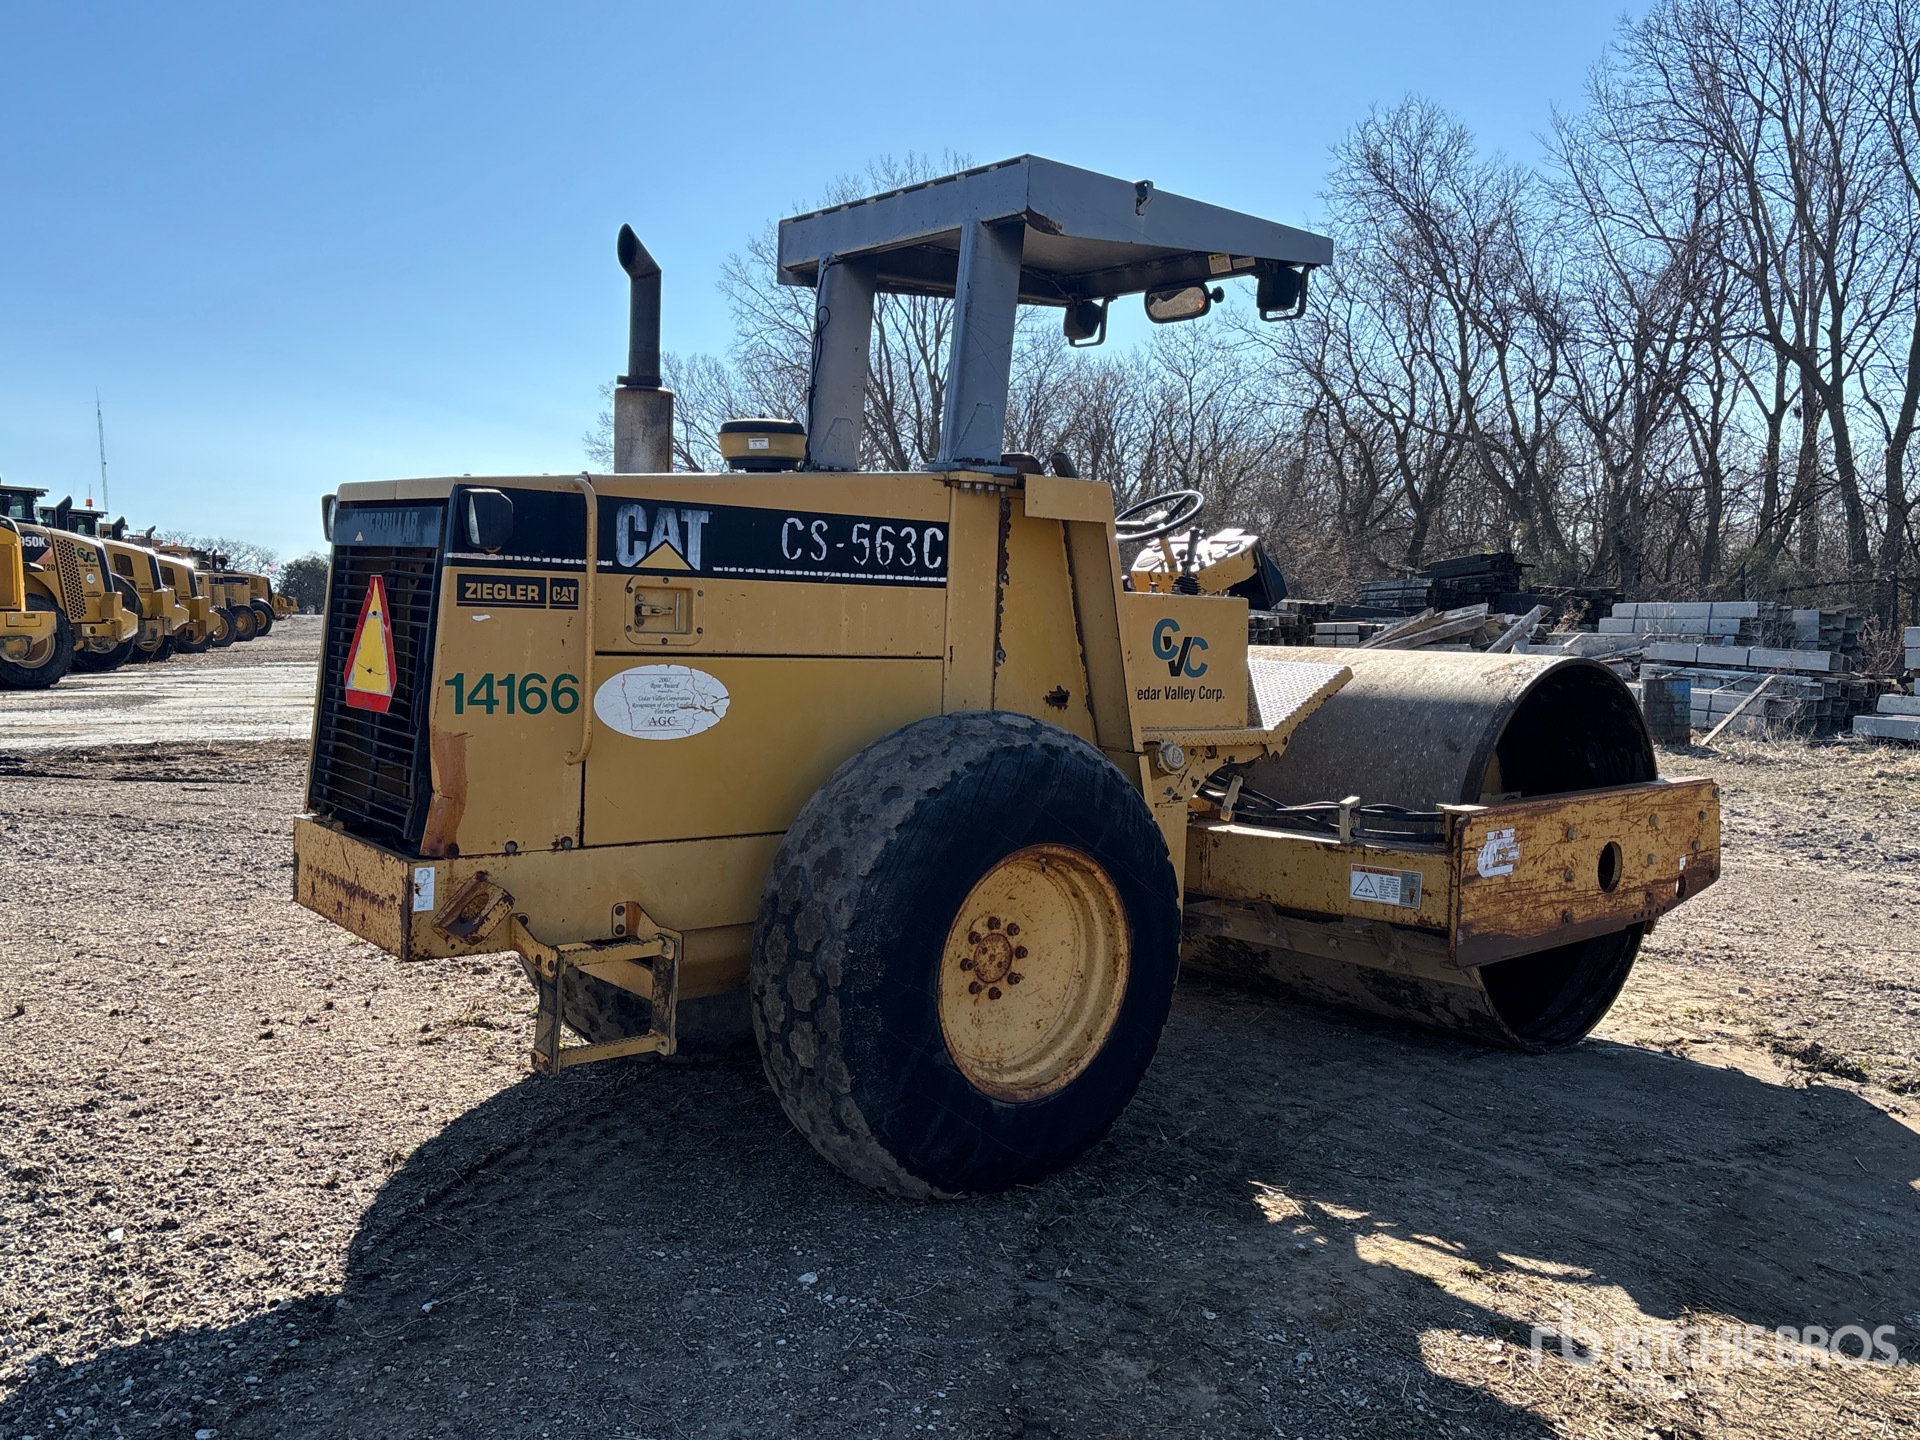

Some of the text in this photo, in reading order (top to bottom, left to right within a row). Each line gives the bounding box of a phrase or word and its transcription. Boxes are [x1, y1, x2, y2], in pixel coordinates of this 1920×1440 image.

[352, 511, 419, 542] TERPILLAR
[616, 503, 710, 571] CAT
[781, 517, 944, 569] CS-563C
[465, 582, 540, 601] ZIEGLER
[552, 586, 578, 602] CAT
[1152, 618, 1209, 678] CVC
[445, 672, 580, 715] 14166
[1134, 685, 1225, 703] edar Valley Corp.
[648, 716, 676, 726] AGC
